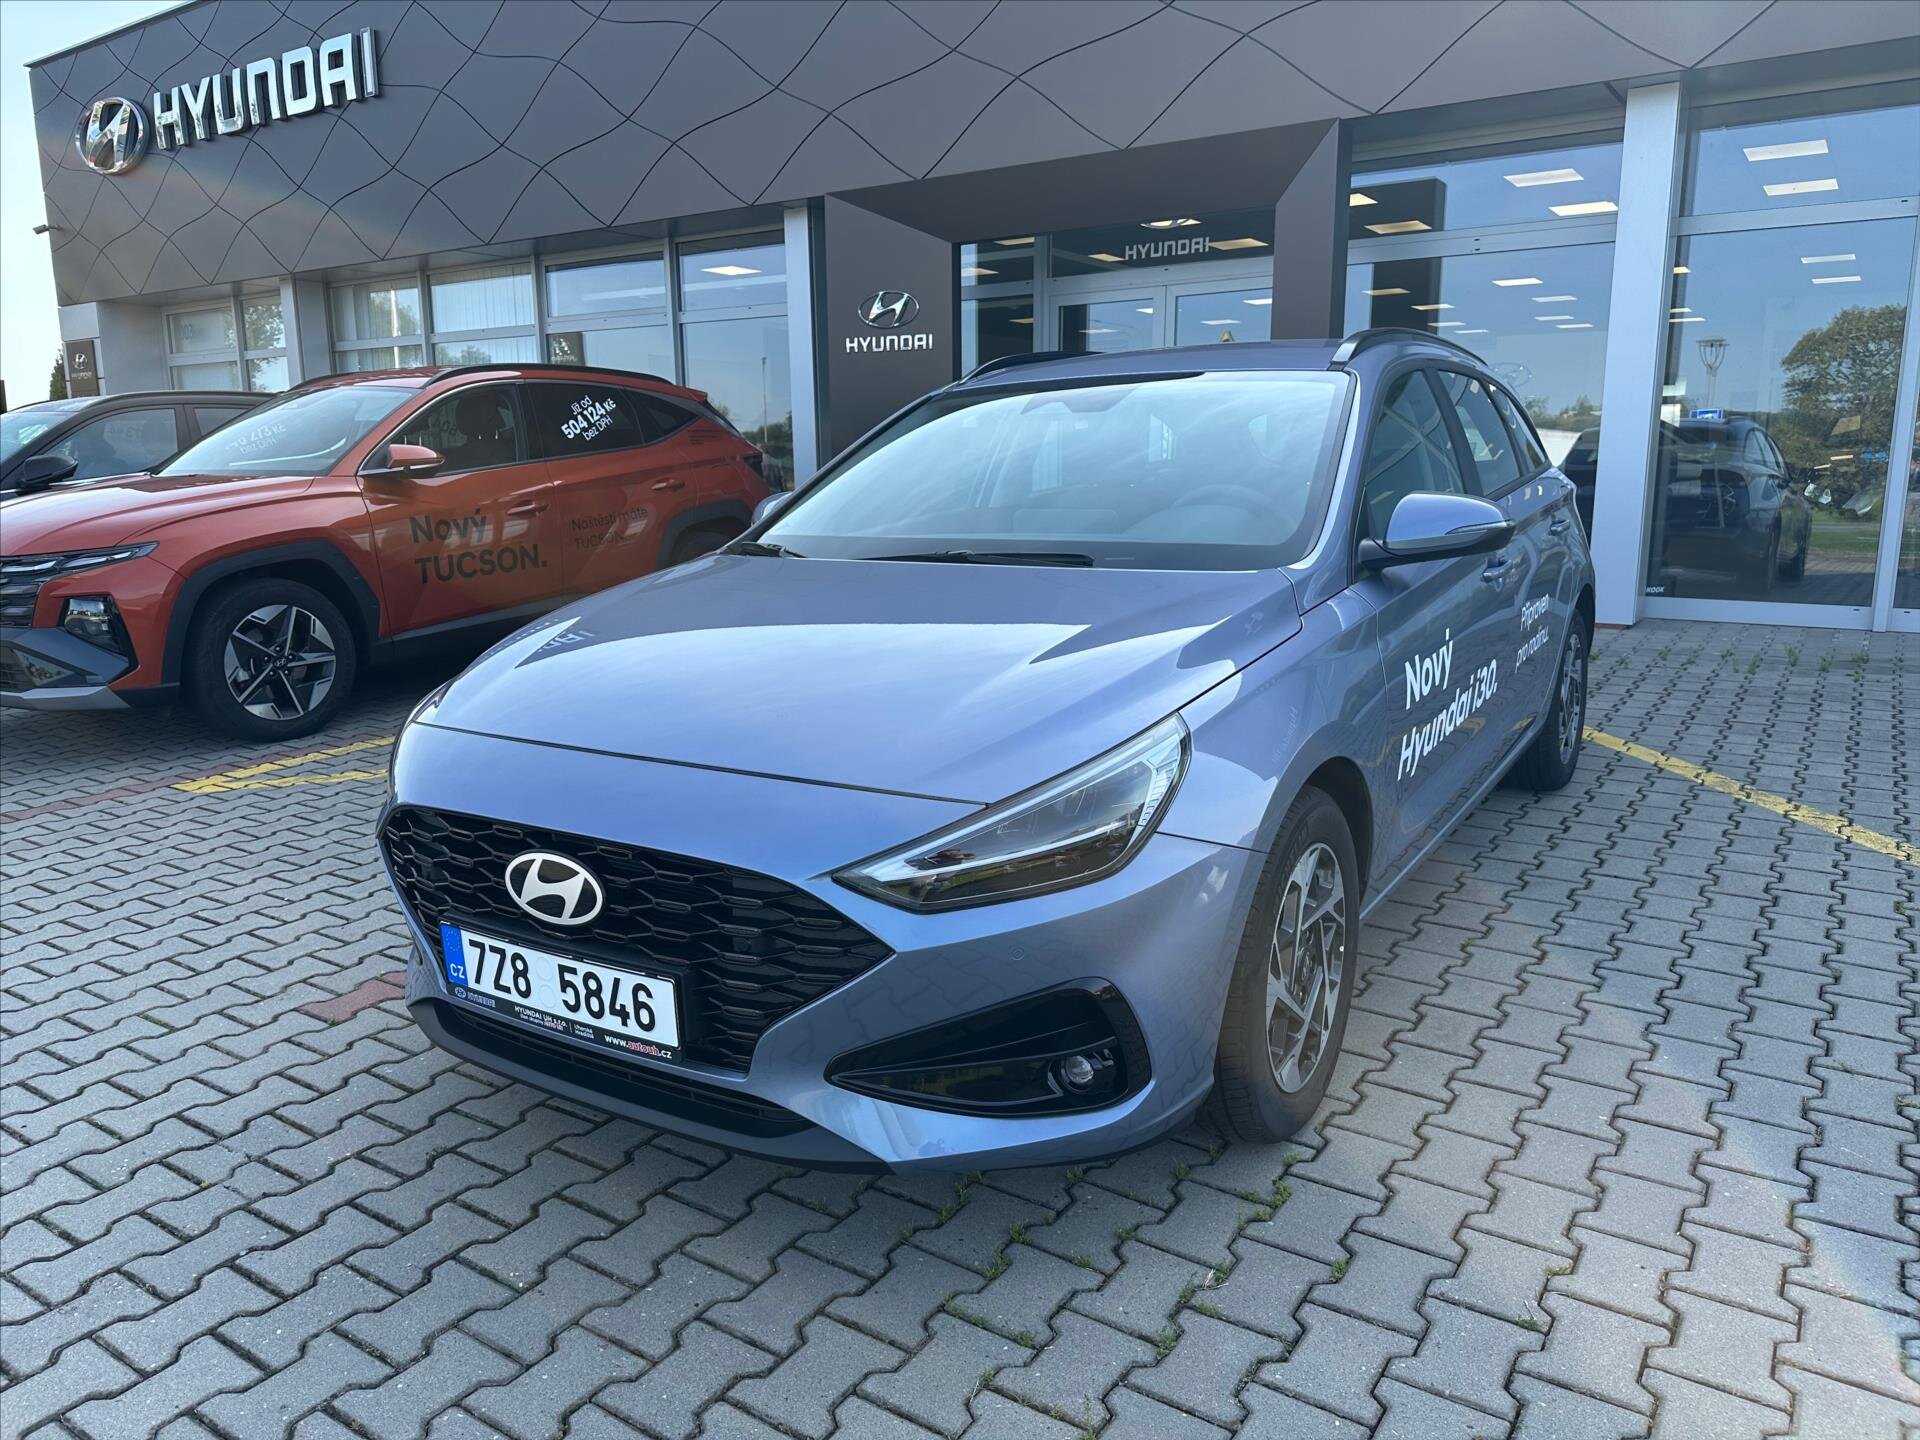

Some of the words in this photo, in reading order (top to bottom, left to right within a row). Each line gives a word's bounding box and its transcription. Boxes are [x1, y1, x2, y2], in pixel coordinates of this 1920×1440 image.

[153, 26, 377, 150] HYUNDAI
[1124, 237, 1210, 260] HYUNDAI
[845, 333, 933, 353] HYUNDAI
[561, 414, 588, 439] 504
[582, 402, 606, 423] 124
[603, 398, 616, 412] Kč
[571, 402, 582, 415] Již
[580, 394, 592, 408] od
[582, 426, 599, 441] bez
[595, 414, 613, 431] DPH
[409, 507, 487, 545] Nový
[415, 543, 548, 585] TUCSON.
[1405, 628, 1453, 710] Nový
[1397, 674, 1474, 782] Hyundai
[1472, 659, 1498, 713] i30.
[450, 963, 465, 979] CZ
[468, 939, 531, 999] 7Z8
[557, 963, 656, 1033] 5846
[514, 1005, 542, 1020] HYUNDAI
